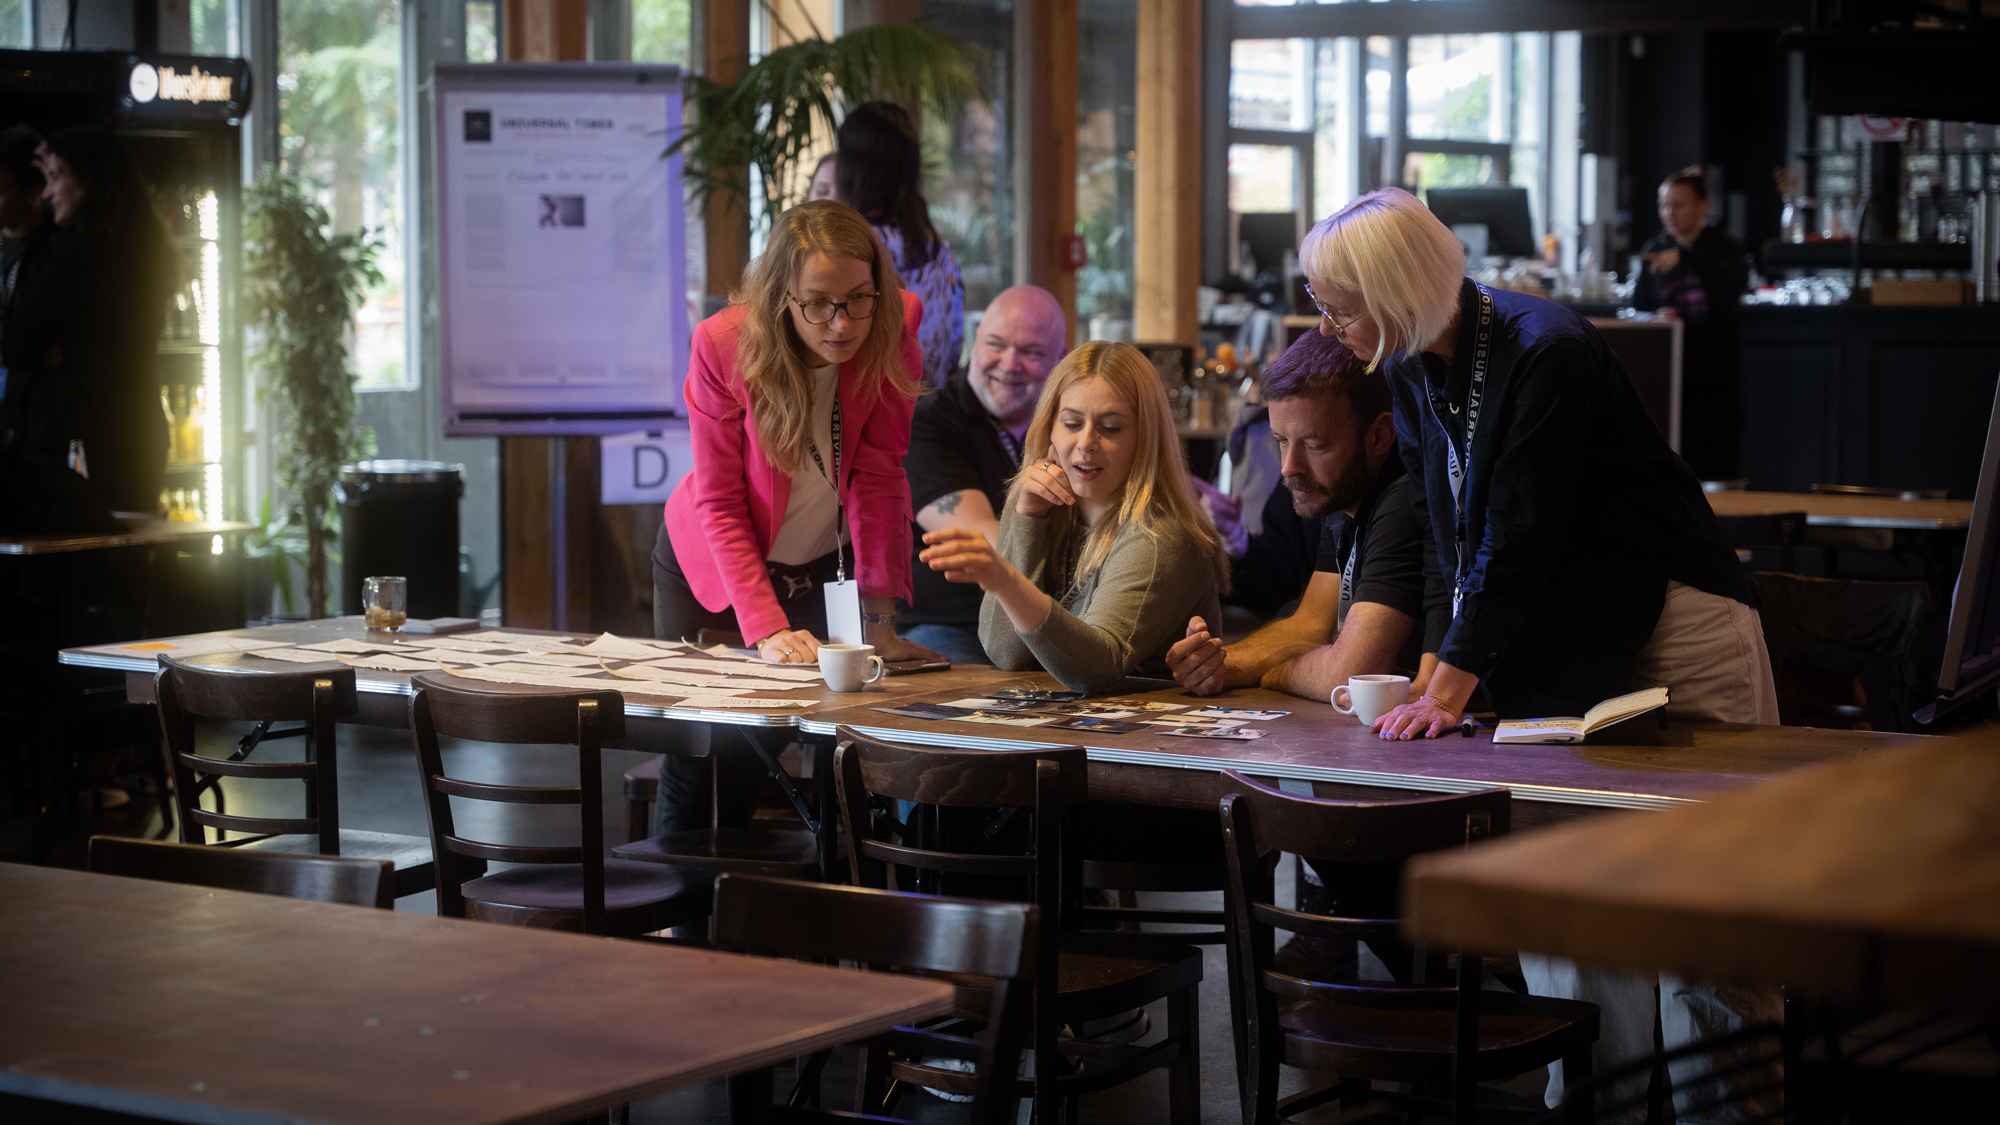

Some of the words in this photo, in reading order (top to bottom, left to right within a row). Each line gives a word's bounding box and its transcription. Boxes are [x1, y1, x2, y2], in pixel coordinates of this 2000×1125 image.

[632, 445, 670, 490] D
[1449, 449, 1460, 478] OUP
[1341, 551, 1356, 601] UNIVER
